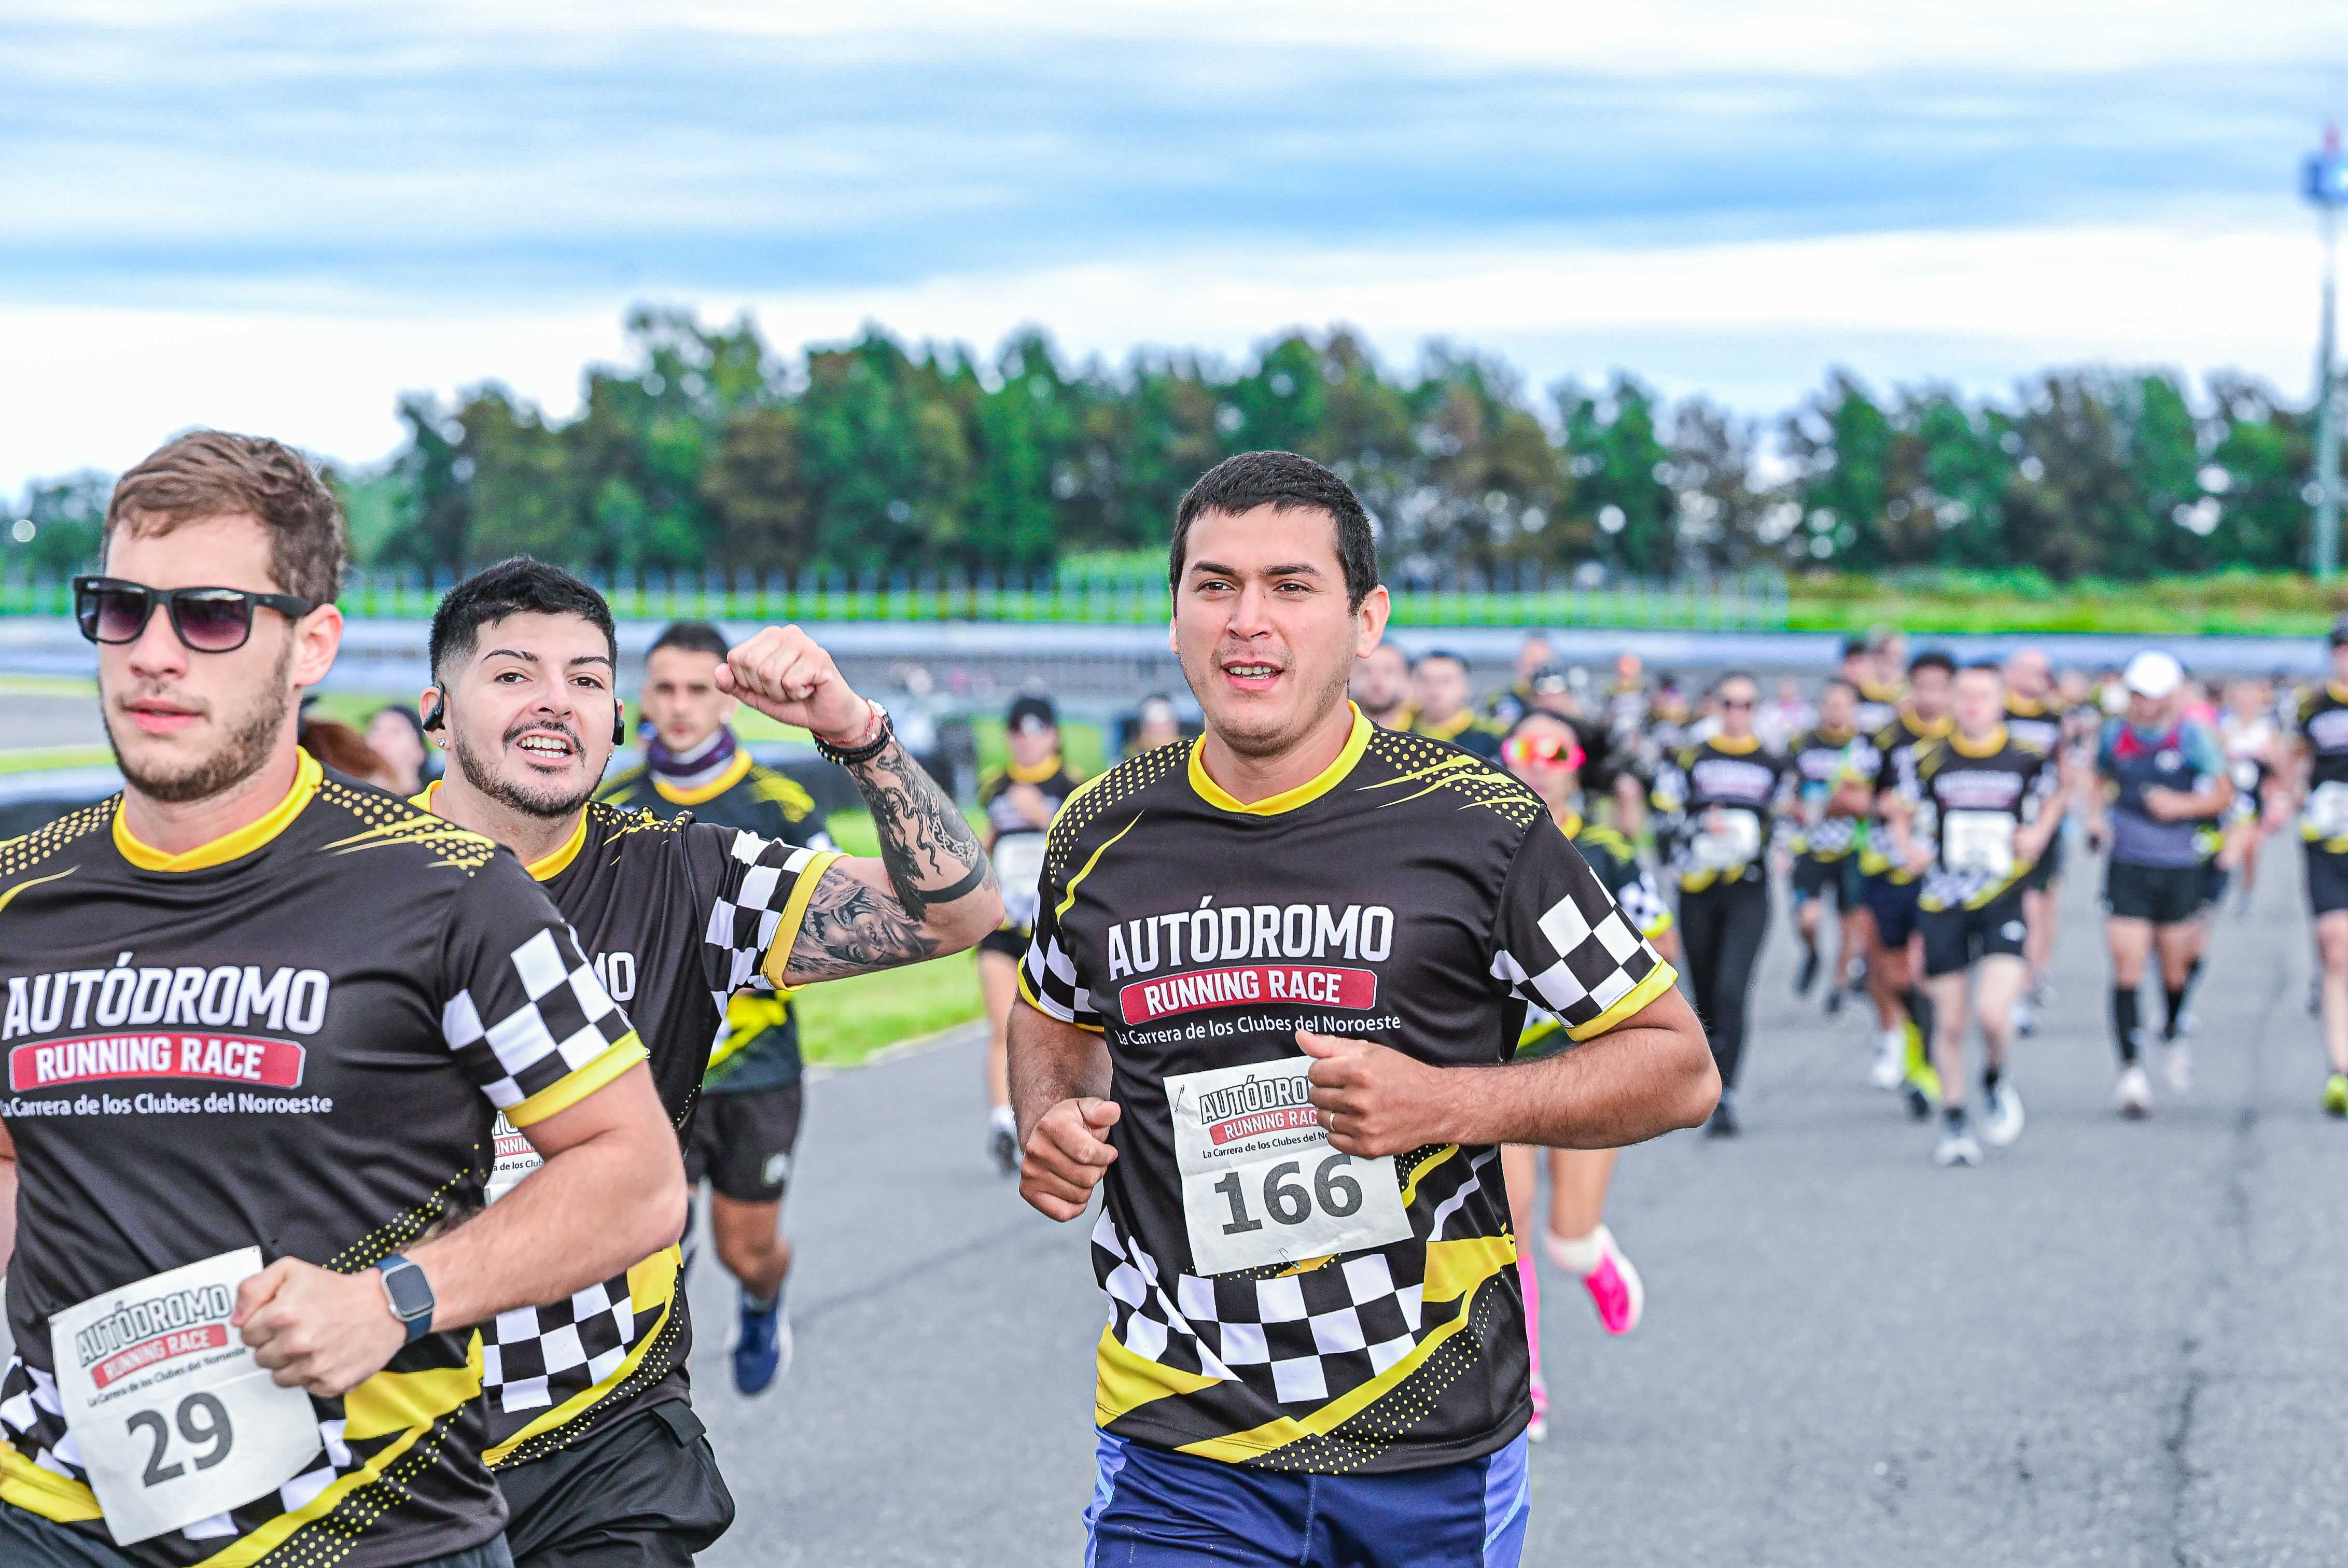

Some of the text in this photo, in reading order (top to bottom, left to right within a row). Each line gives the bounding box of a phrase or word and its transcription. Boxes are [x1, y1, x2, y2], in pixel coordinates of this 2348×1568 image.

[1108, 895, 1394, 982] AUTÓDROMO
[2, 951, 330, 1039] AUTÓDROMO
[1144, 970, 1343, 1016] RUNNING RACE
[1128, 1028, 1182, 1045] Carrera
[1185, 1022, 1206, 1040] de
[1208, 1019, 1234, 1037] los
[1237, 1016, 1292, 1034] Clubes
[1295, 1015, 1319, 1033] del
[1323, 1014, 1401, 1033] Noroeste
[35, 1037, 265, 1084] RUNNING RACE
[10, 1097, 72, 1117] Carrera
[74, 1094, 100, 1115] de
[102, 1093, 132, 1115] los
[134, 1093, 201, 1114] Clubes
[204, 1093, 235, 1113] del
[239, 1095, 332, 1114] Noroeste
[1199, 1074, 1309, 1125] AUTÓDRO
[1203, 1150, 1212, 1159] La
[1213, 1146, 1243, 1157] Carrera
[1245, 1142, 1256, 1152] de
[1257, 1141, 1270, 1150] los
[1272, 1137, 1301, 1147] Clubes
[1303, 1132, 1317, 1142] del
[1223, 1109, 1318, 1140] RUNNING RAC
[500, 1162, 510, 1171] de
[512, 1161, 523, 1170] los
[525, 1159, 543, 1168] Club
[1214, 1154, 1363, 1235] 166
[75, 1284, 233, 1369] AUTÓDROMO
[103, 1328, 211, 1382] RUNNING RACE
[127, 1392, 233, 1488] 29
